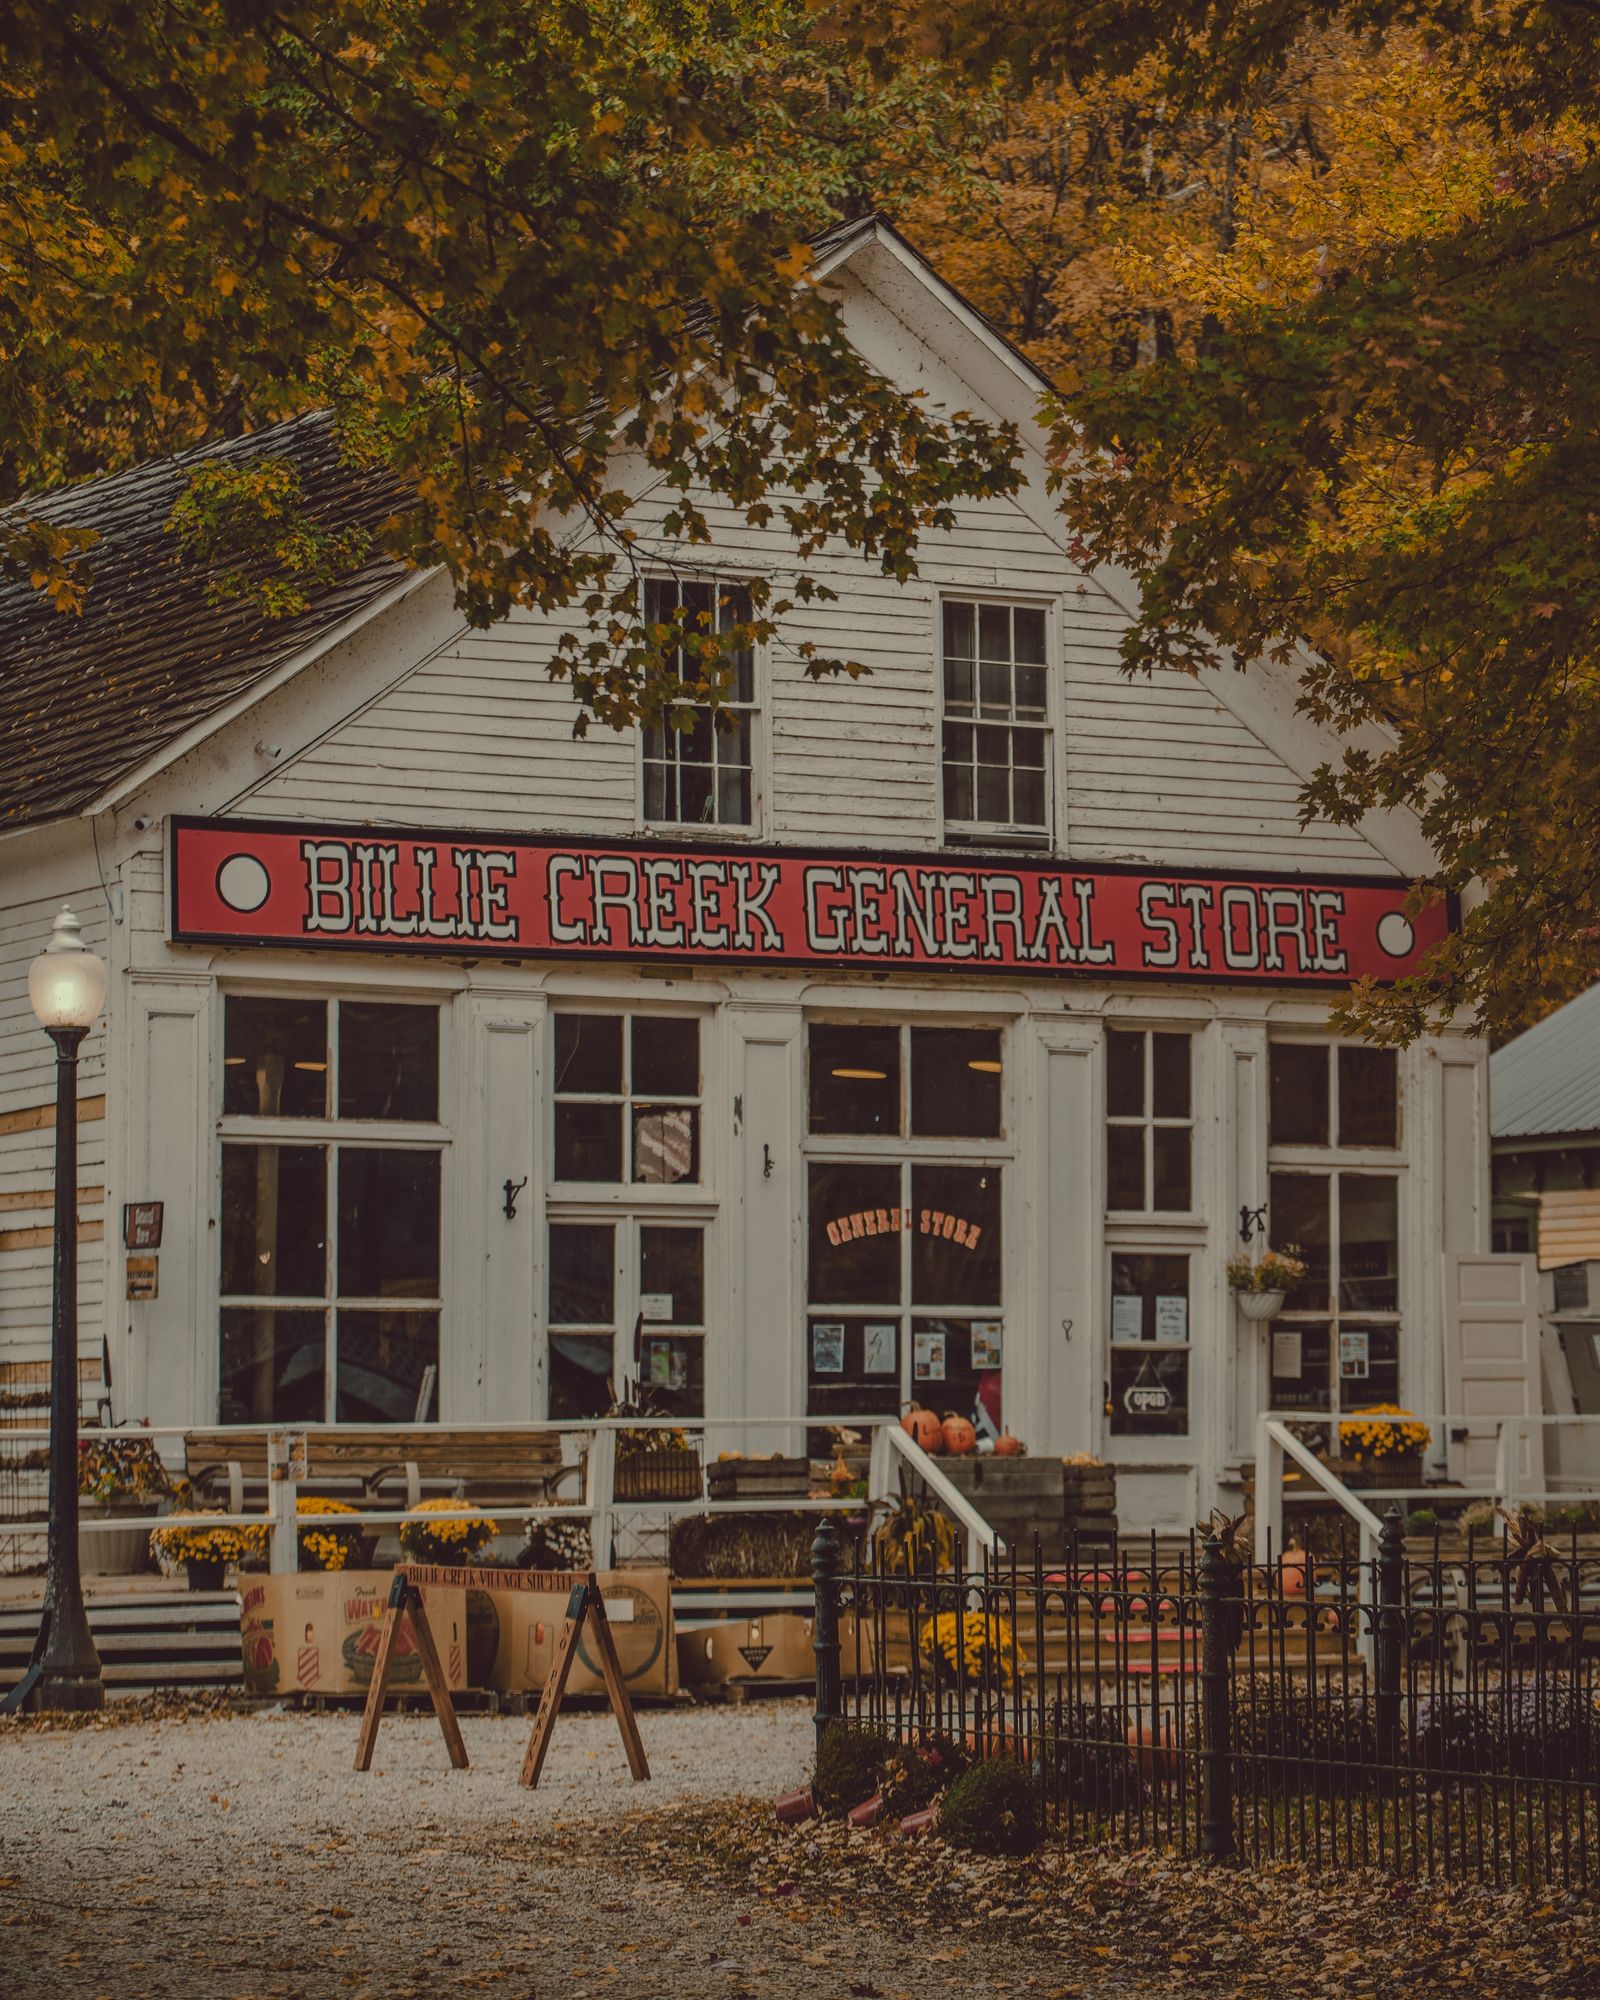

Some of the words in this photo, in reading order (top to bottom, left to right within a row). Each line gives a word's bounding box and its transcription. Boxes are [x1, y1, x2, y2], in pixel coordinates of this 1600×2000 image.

[301, 840, 519, 941] BILLIE
[545, 852, 785, 951] CREEK
[803, 866, 1116, 966] GENERAL
[1138, 882, 1348, 973] STORE
[826, 1208, 912, 1247] GENERAL
[920, 1209, 982, 1250] STORE
[1133, 1392, 1166, 1411] open
[409, 1566, 438, 1583] BILLIE
[443, 1568, 476, 1586] CREEK
[480, 1570, 523, 1589] VILLAGE
[354, 1586, 377, 1598] Fresh
[559, 1622, 573, 1650] NO
[521, 1669, 558, 1779] PARKING
